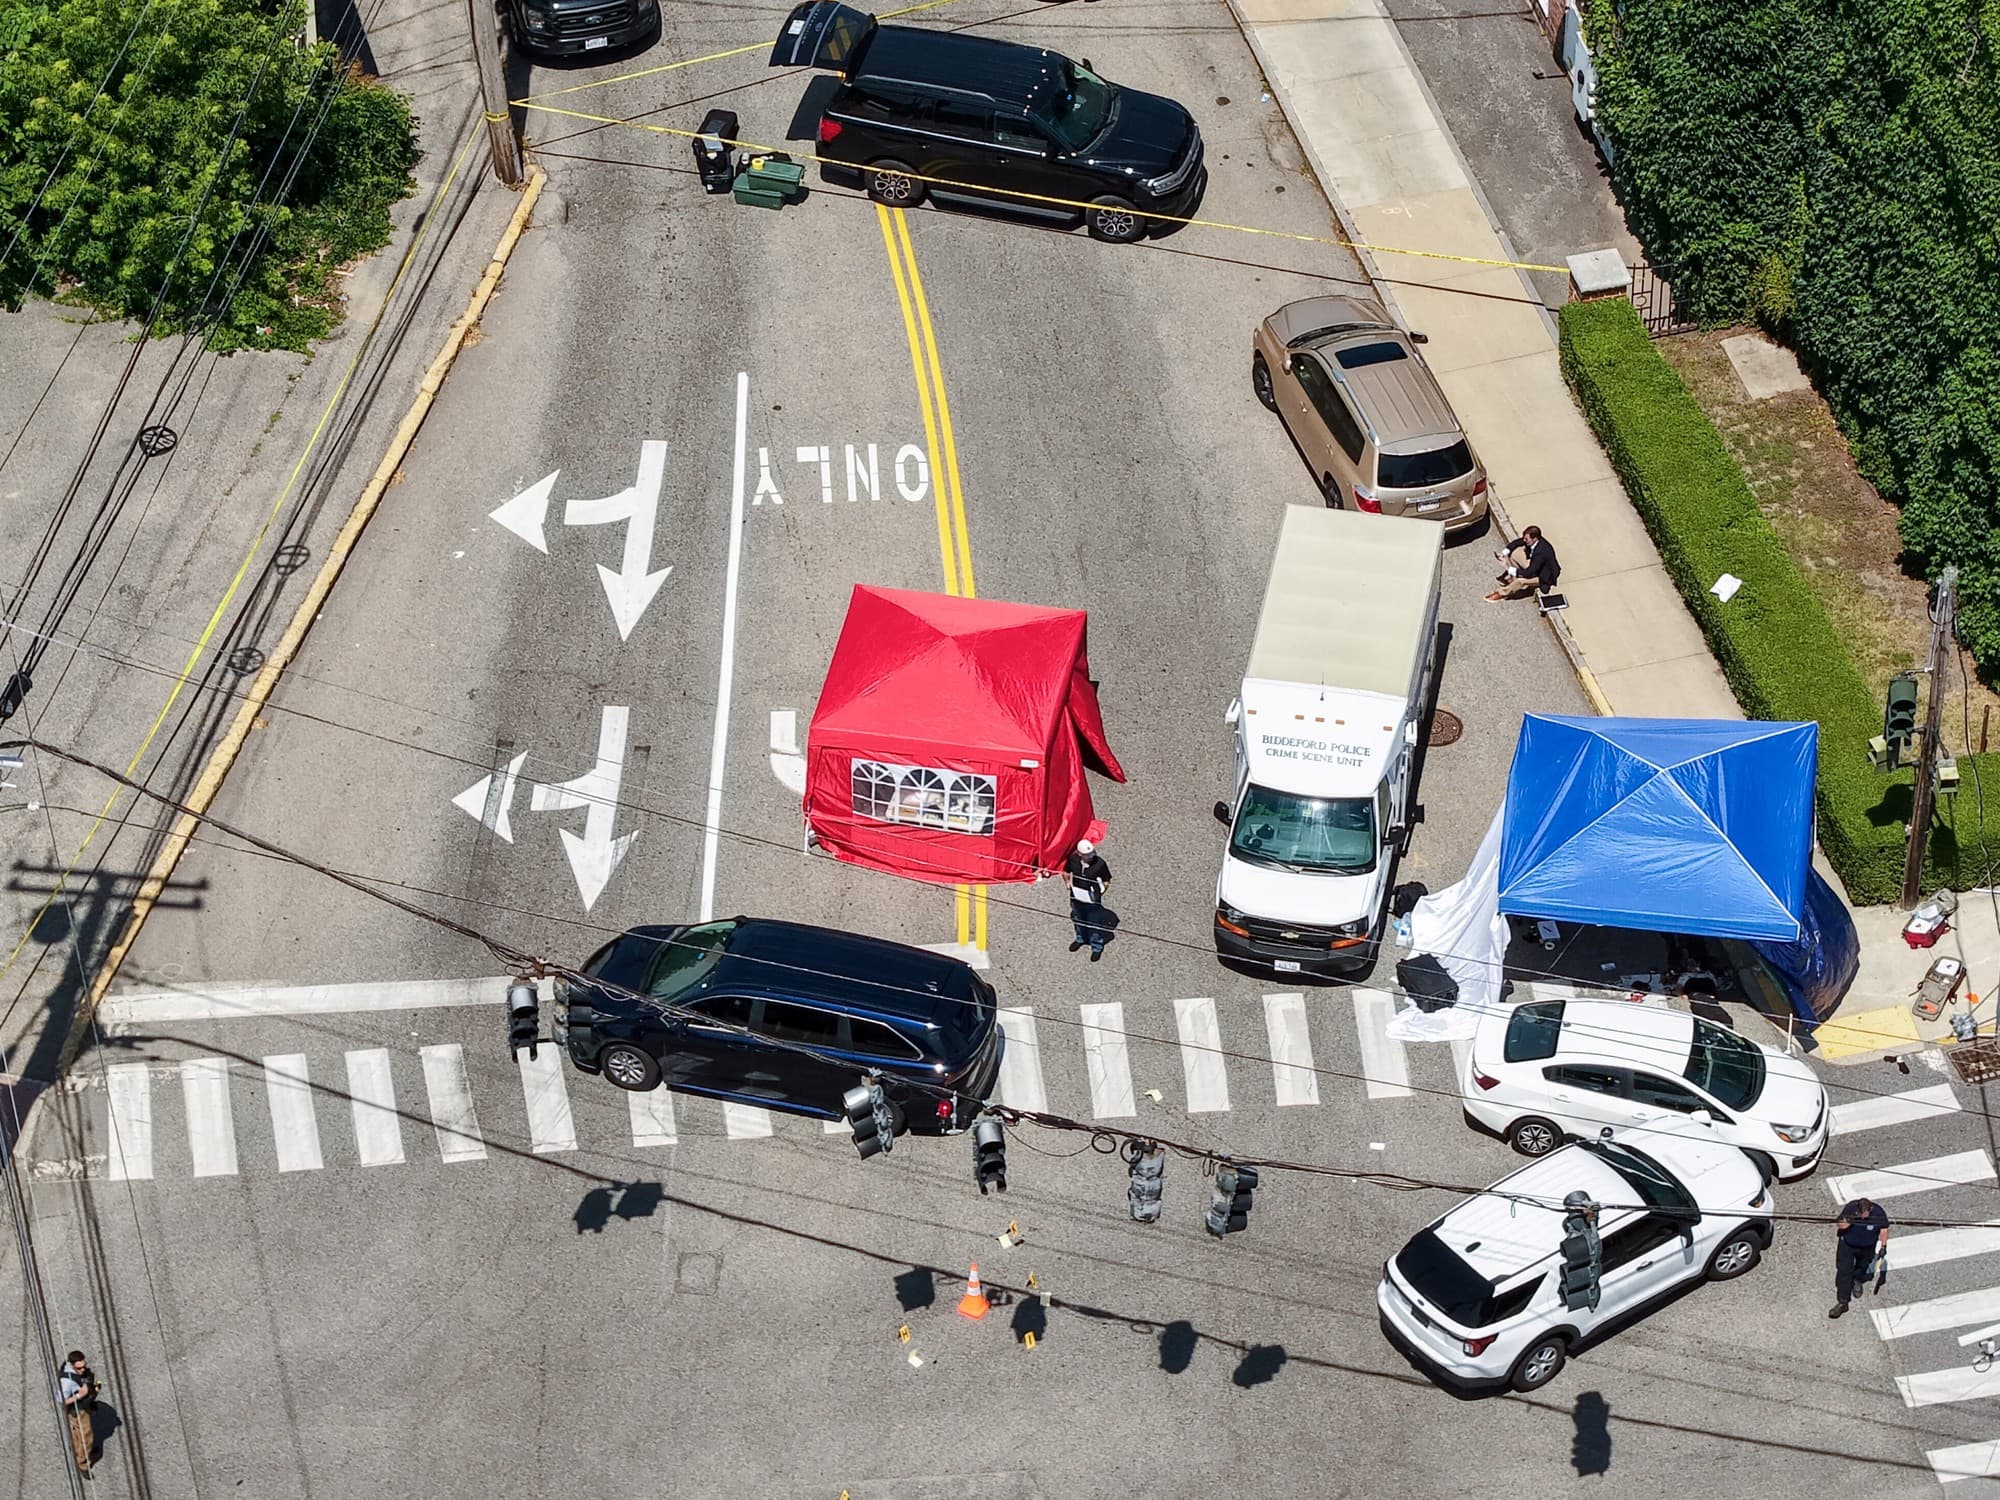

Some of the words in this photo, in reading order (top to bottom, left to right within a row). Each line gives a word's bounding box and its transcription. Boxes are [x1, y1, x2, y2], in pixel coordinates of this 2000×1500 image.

[752, 443, 929, 505] ONLY
[1262, 734, 1327, 750] BIDDEFORD
[1330, 743, 1371, 757] POLICE
[1265, 748, 1298, 759] CRIME
[1302, 751, 1334, 763] SCENE
[1337, 756, 1364, 767] UNIT
